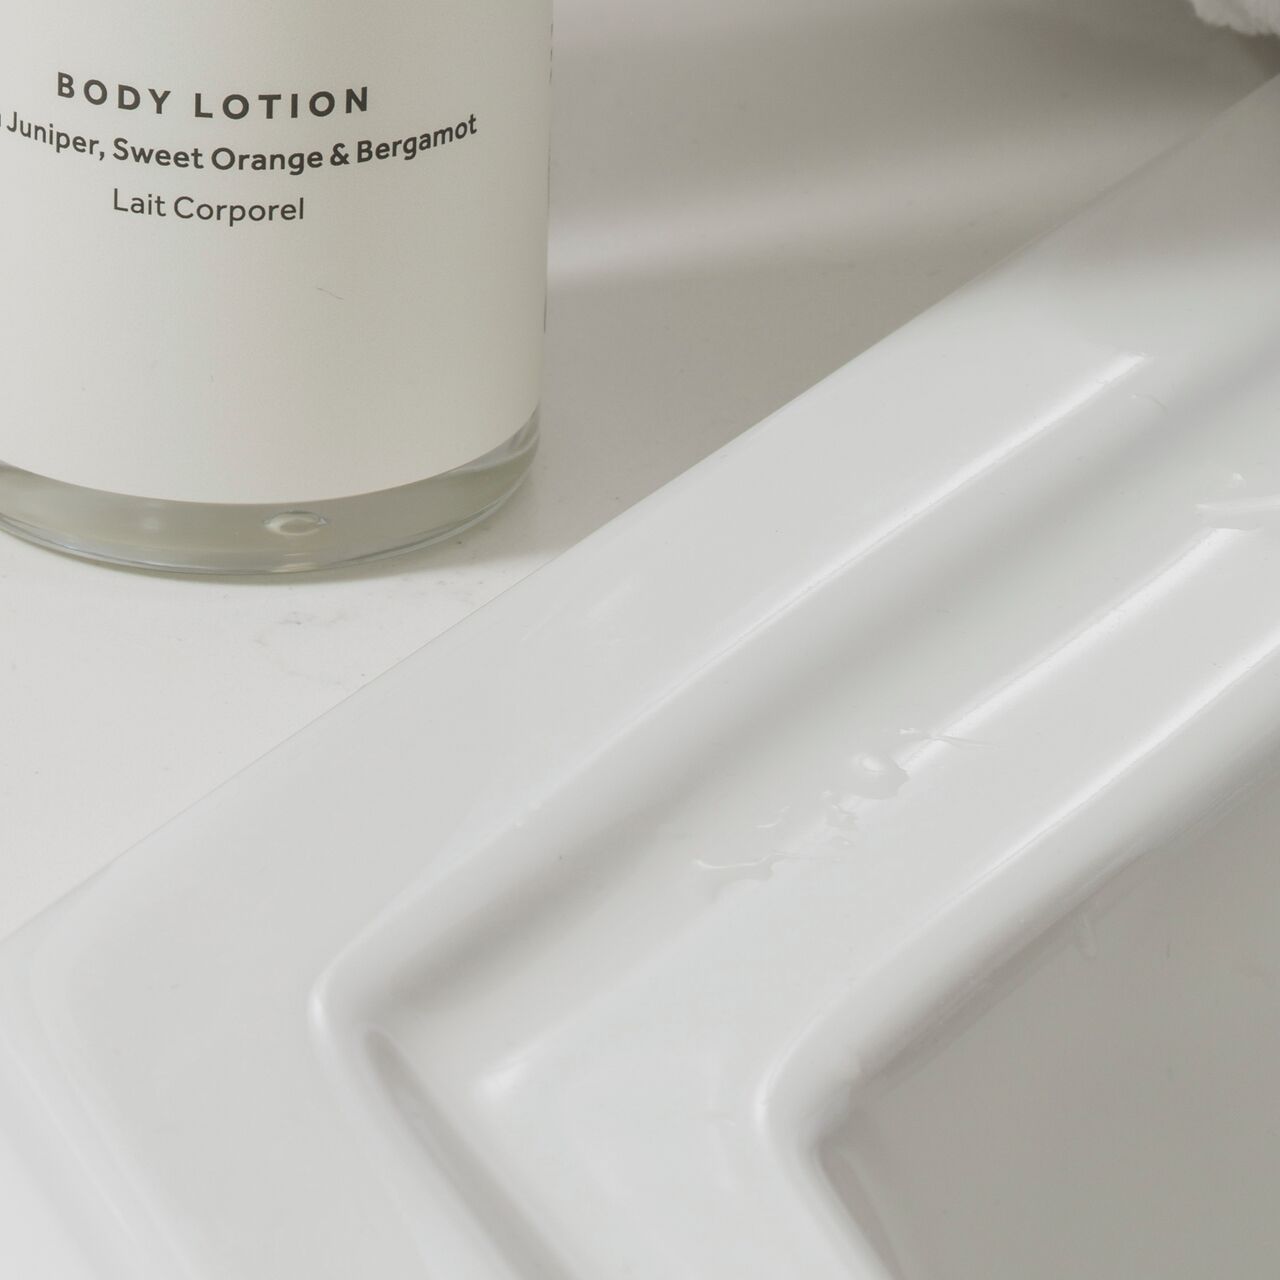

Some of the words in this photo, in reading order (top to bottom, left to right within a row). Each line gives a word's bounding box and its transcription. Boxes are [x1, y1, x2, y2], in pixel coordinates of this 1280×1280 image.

[57, 71, 172, 115] BODY
[194, 85, 368, 121] LOTION
[6, 111, 105, 162] Juniper,
[112, 137, 205, 170] Sweet
[210, 146, 324, 176] Orange
[329, 142, 351, 167] &
[356, 113, 478, 164] Bergamot
[113, 187, 167, 218] Lait
[173, 195, 305, 228] Corporel
